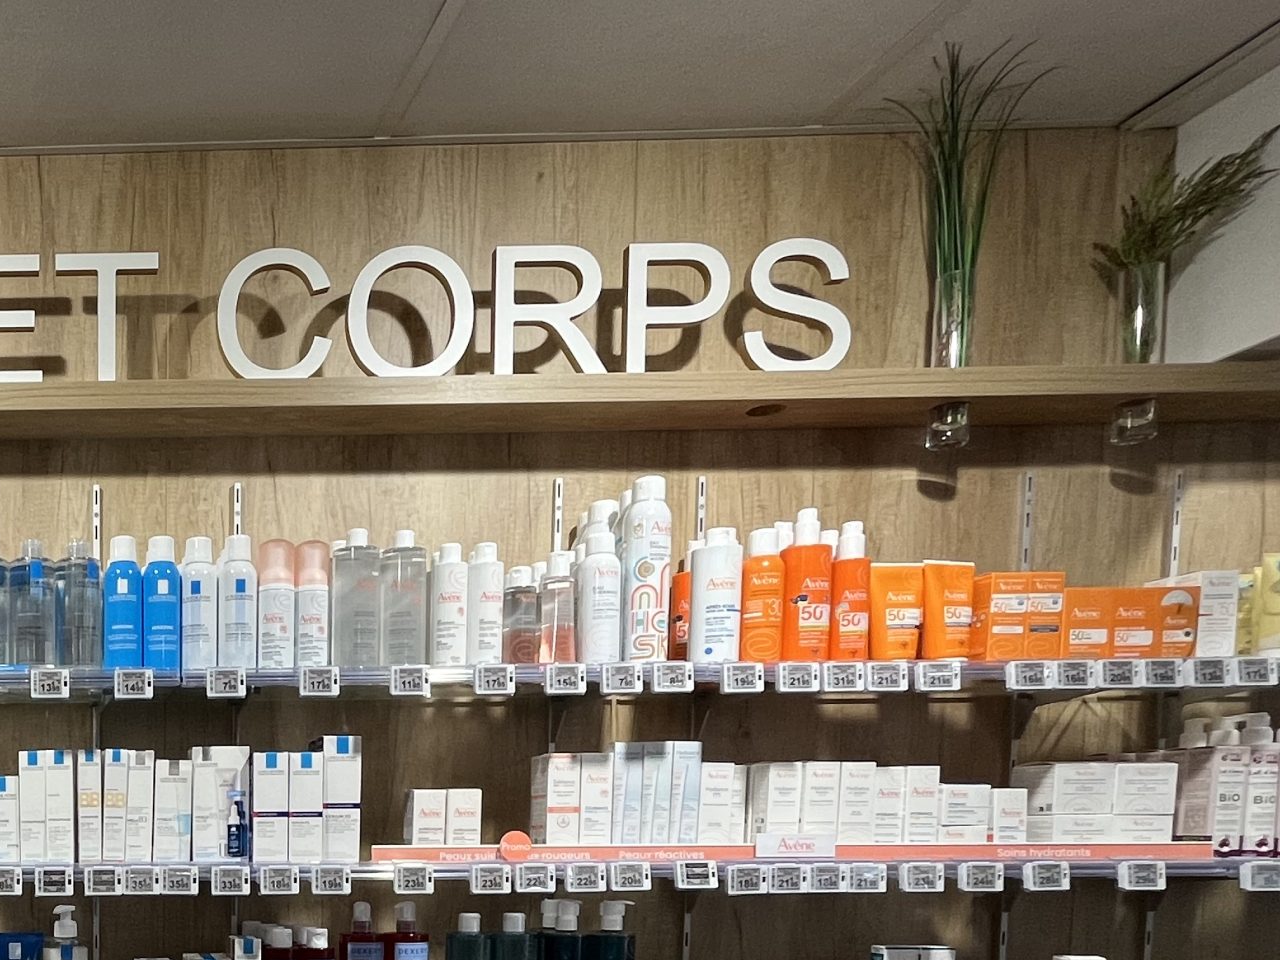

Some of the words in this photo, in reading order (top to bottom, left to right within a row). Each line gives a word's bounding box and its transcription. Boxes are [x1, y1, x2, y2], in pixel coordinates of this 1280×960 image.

[216, 236, 853, 380] CORPS
[801, 605, 823, 621] 50
[887, 609, 906, 621] 50
[946, 607, 962, 619] 50
[841, 614, 861, 628] 50
[777, 837, 816, 851] Avène
[618, 850, 652, 860] Peaux
[997, 848, 1026, 857] Soins
